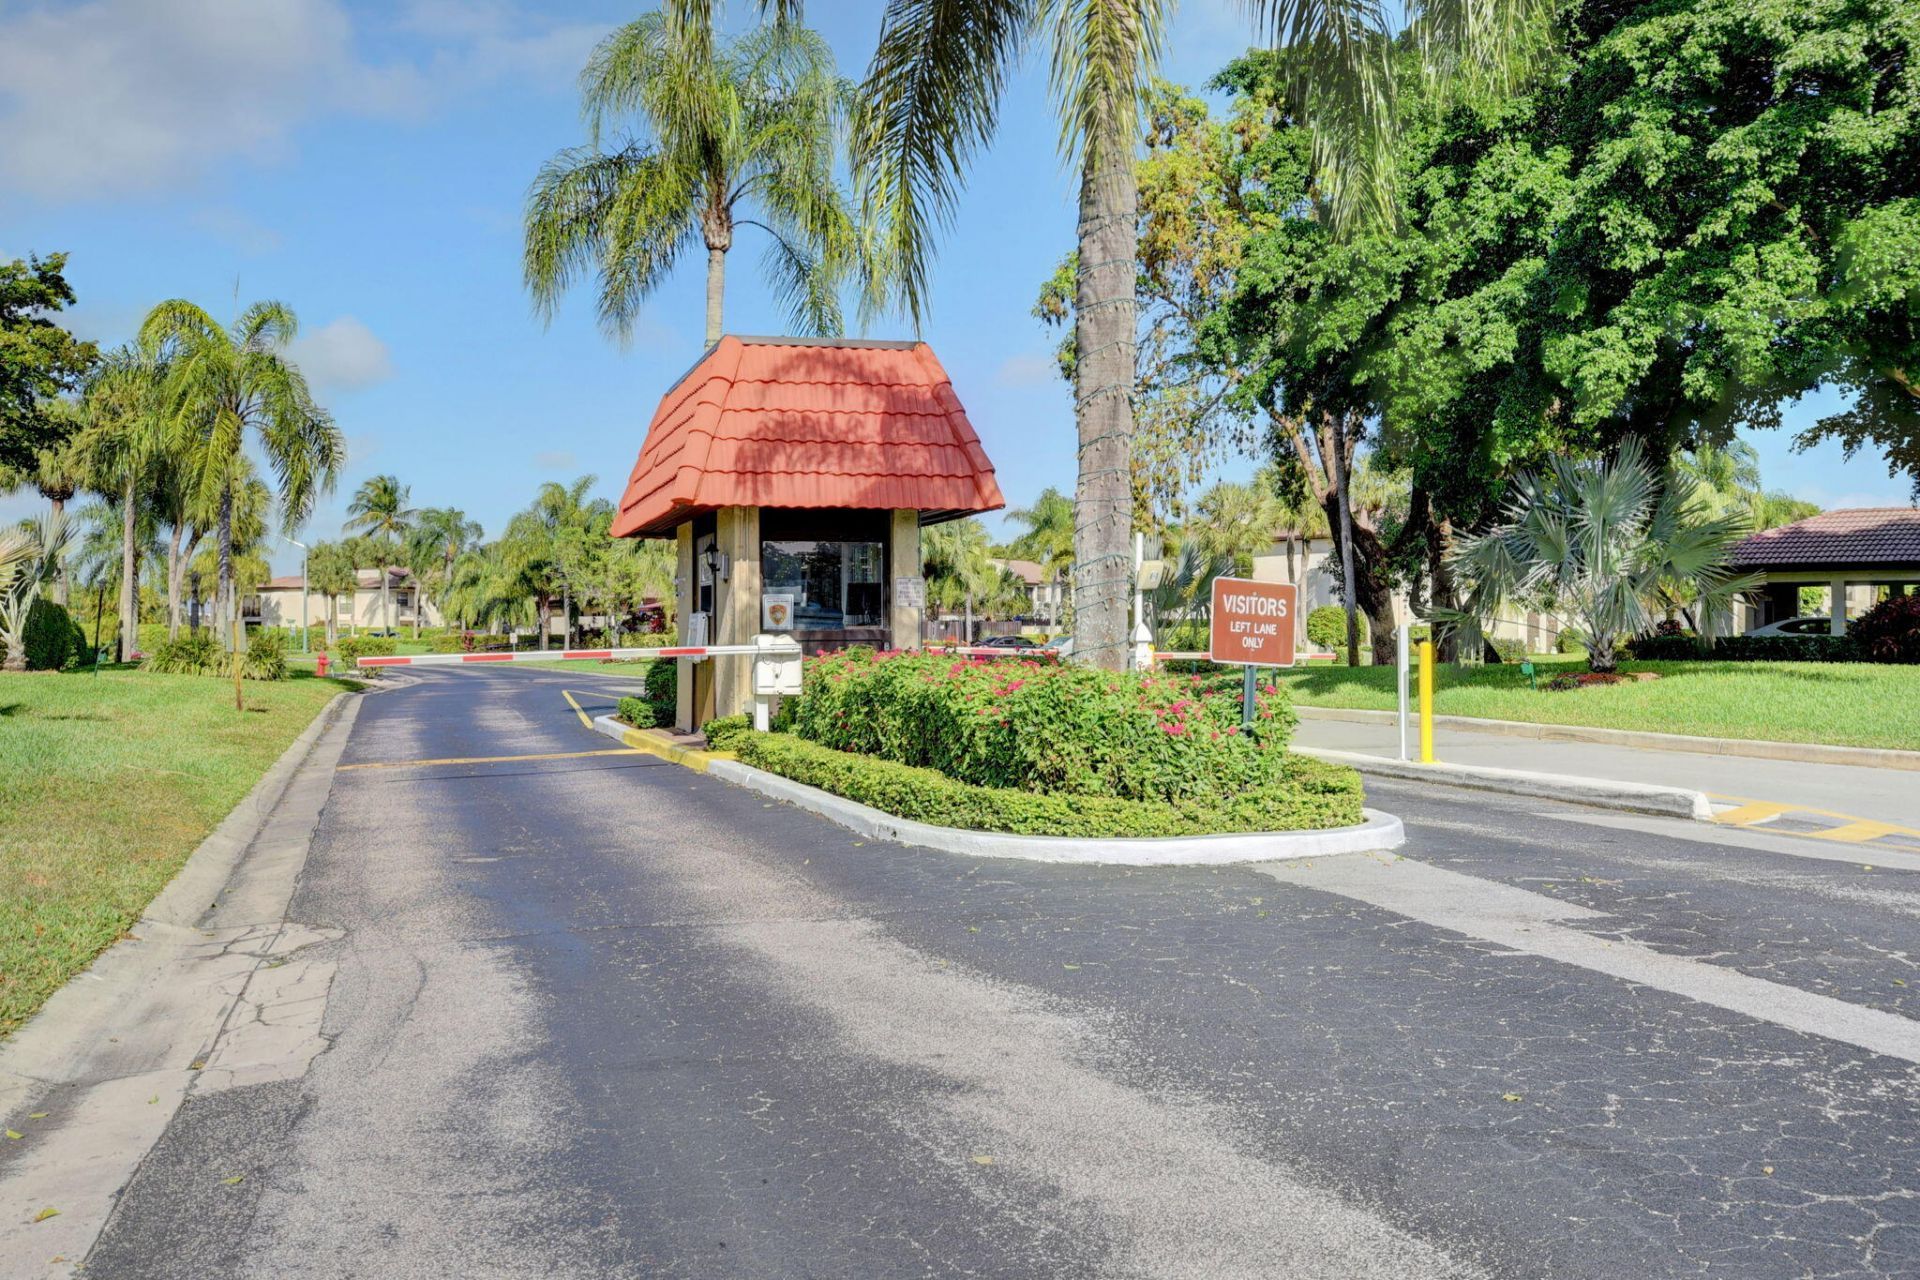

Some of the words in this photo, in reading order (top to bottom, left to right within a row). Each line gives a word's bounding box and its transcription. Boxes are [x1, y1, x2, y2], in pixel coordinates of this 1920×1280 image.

[1223, 594, 1287, 617] VISITORS
[1230, 621, 1251, 633] LEFT
[1254, 622, 1277, 635] LANE
[1242, 637, 1264, 648] ONLY
